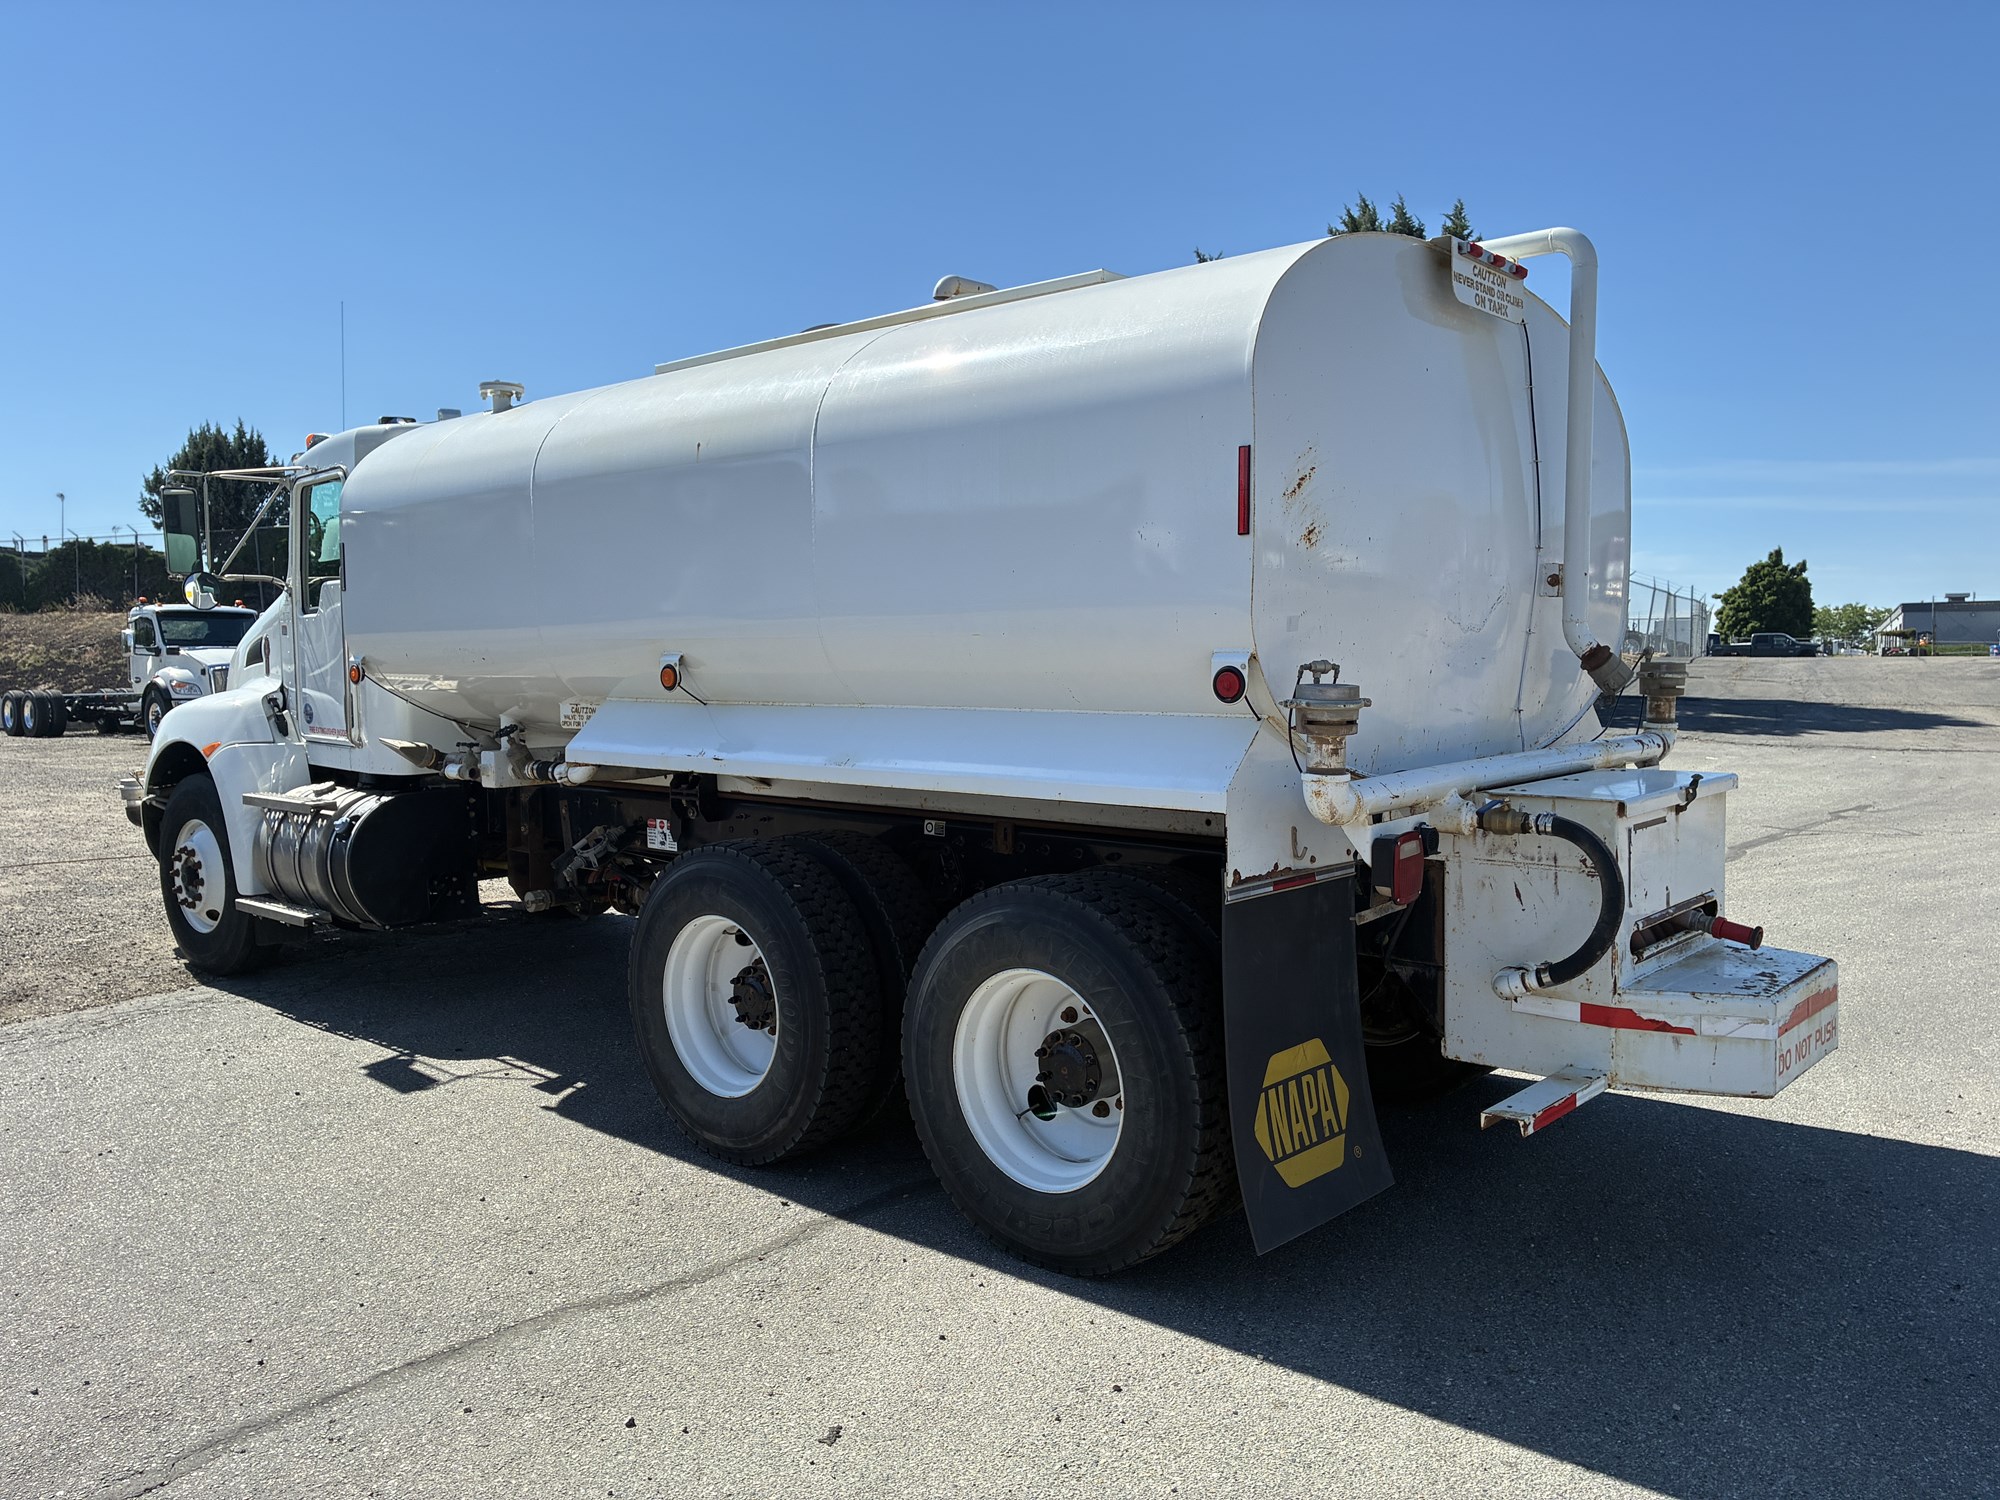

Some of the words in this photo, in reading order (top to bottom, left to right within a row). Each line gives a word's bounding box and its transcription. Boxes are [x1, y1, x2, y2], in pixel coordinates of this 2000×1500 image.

[1454, 270, 1474, 290] NEVER
[1475, 280, 1496, 298] STAND
[1497, 289, 1505, 302] OR
[1472, 264, 1507, 290] CAUTION
[1474, 293, 1486, 309] ON
[1488, 298, 1508, 318] TANK
[570, 706, 597, 714] CAUTION
[1778, 1048, 1792, 1077] DO
[1795, 1033, 1812, 1065] NOT
[1815, 1017, 1837, 1051] PUSH
[1267, 1067, 1340, 1160] NAPA
